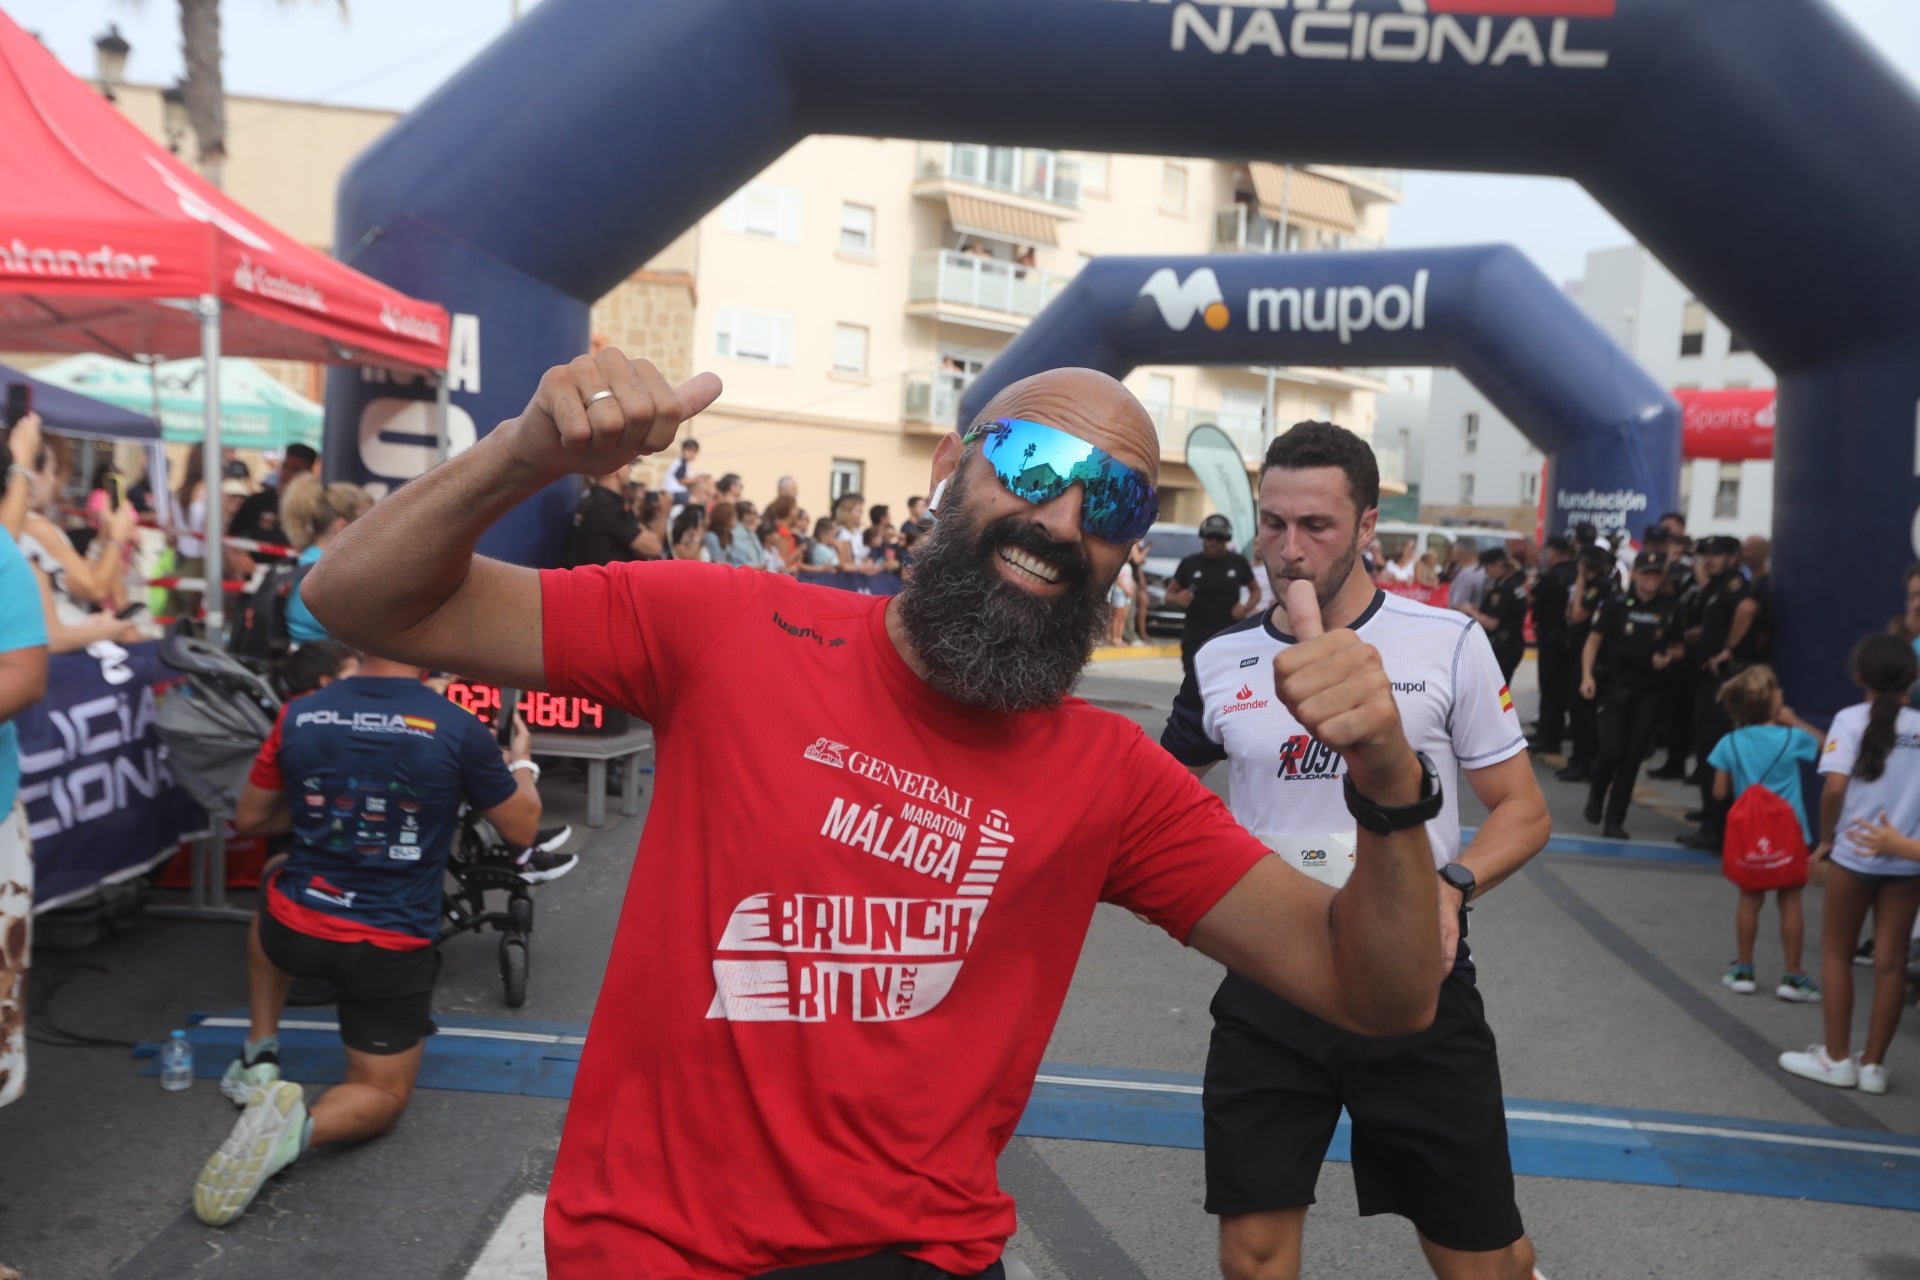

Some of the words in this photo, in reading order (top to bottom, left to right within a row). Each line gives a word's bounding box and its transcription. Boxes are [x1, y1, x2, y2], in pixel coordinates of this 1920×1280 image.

[1170, 3, 1609, 68] NACIONAL
[1247, 268, 1430, 344] mupol
[1684, 403, 1753, 434] Sports
[1557, 487, 1647, 512] fundación
[1222, 700, 1269, 715] Santander
[351, 726, 435, 740] NACIONAL
[848, 751, 974, 820] GENERALI
[1284, 773, 1339, 781] SOLIDARIA
[819, 796, 962, 884] MÁLAGA
[900, 802, 967, 842] MARATÓN
[766, 894, 974, 954] BRUNCH
[786, 962, 893, 1021] RUN
[895, 966, 918, 1016] 2024
